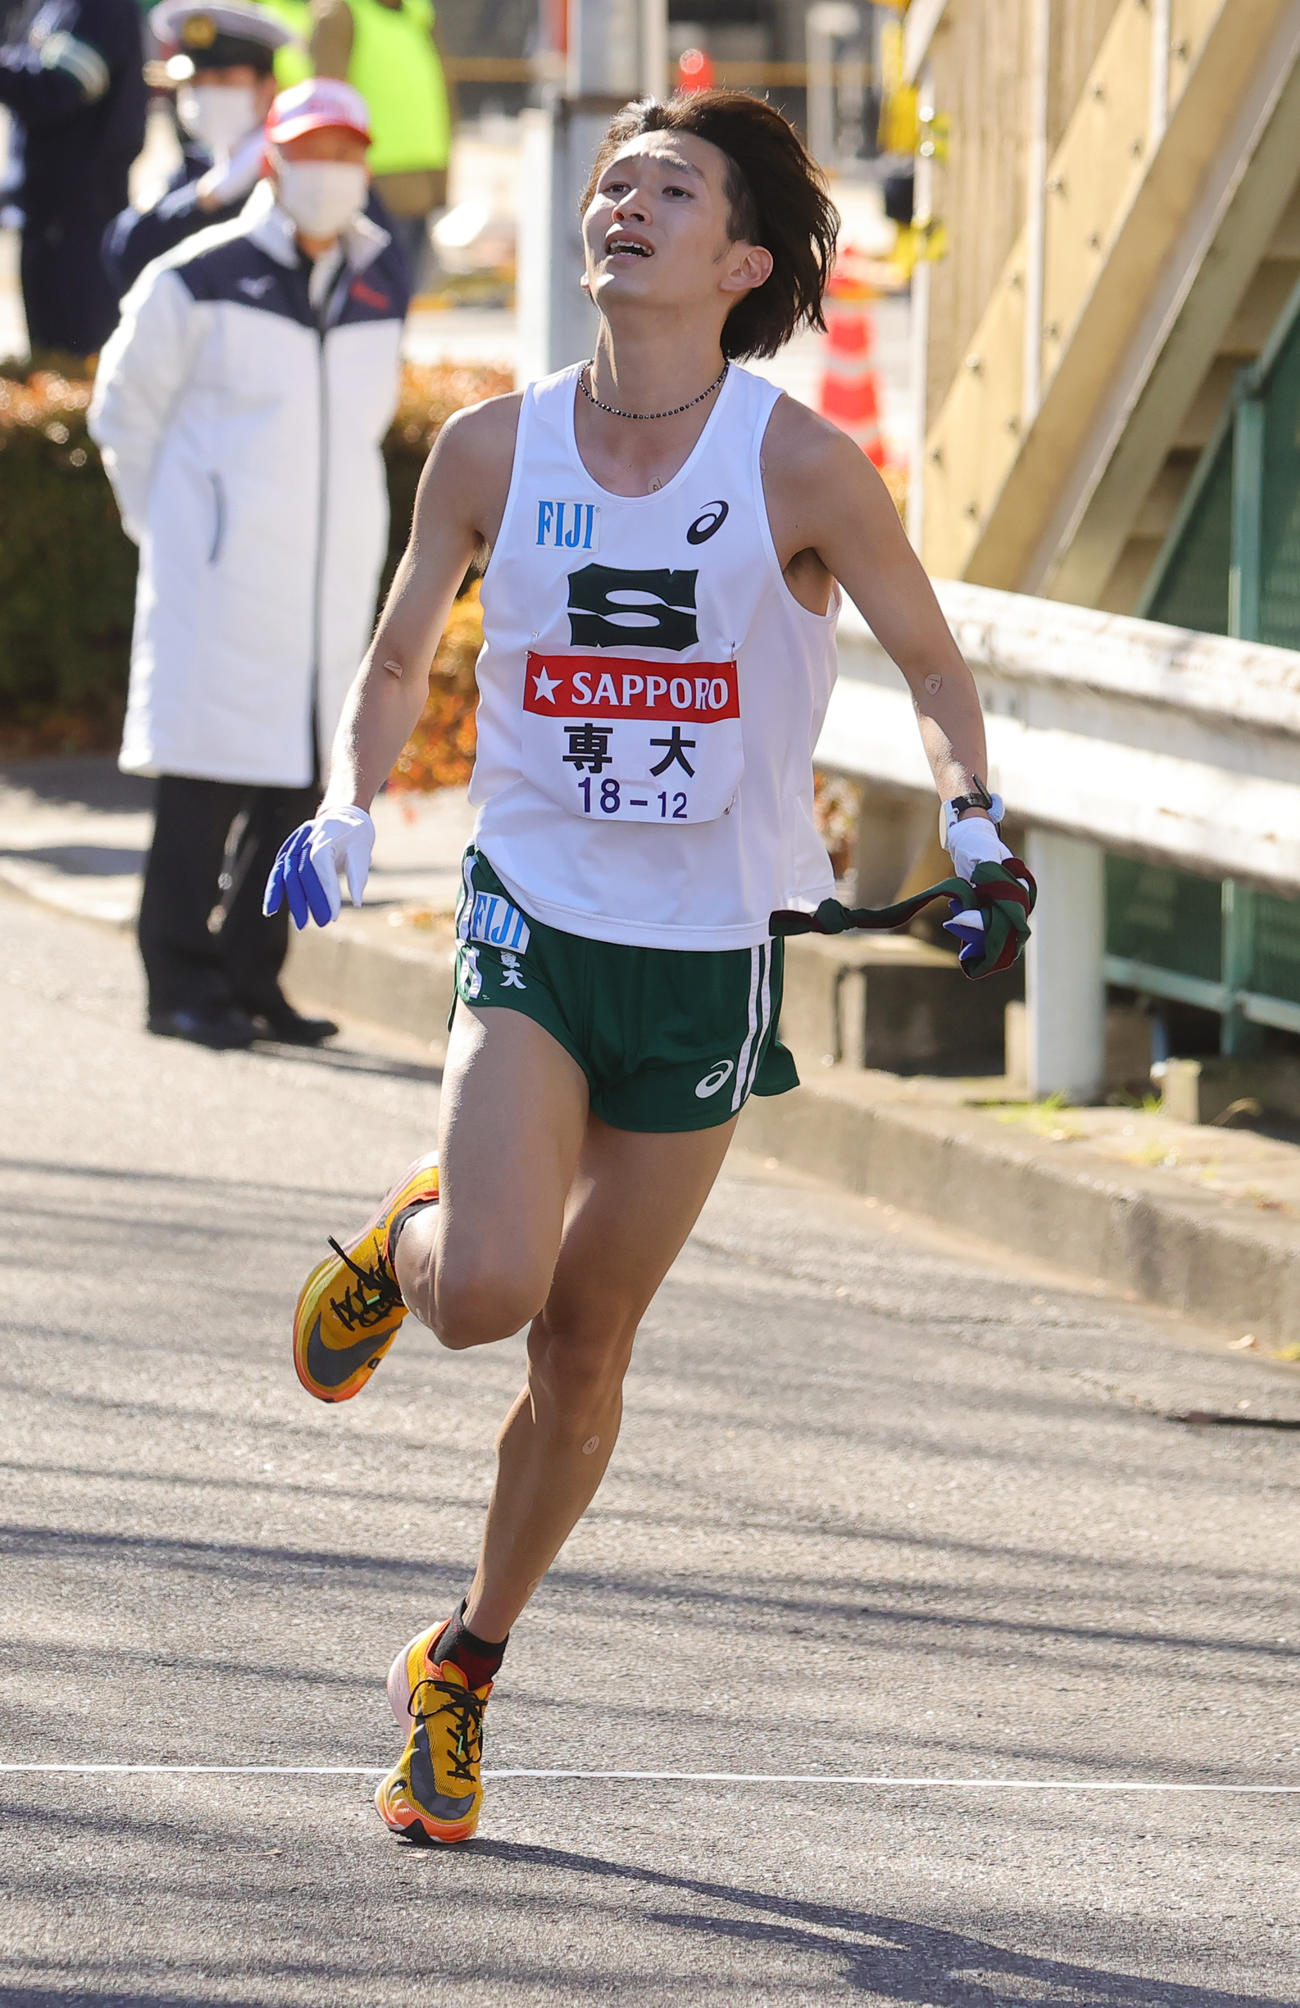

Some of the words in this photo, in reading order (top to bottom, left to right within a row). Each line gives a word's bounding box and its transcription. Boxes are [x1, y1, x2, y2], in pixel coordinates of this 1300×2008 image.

[535, 500, 595, 549] FIJI
[571, 671, 729, 710] SAPPORO
[472, 894, 525, 949] FIJI
